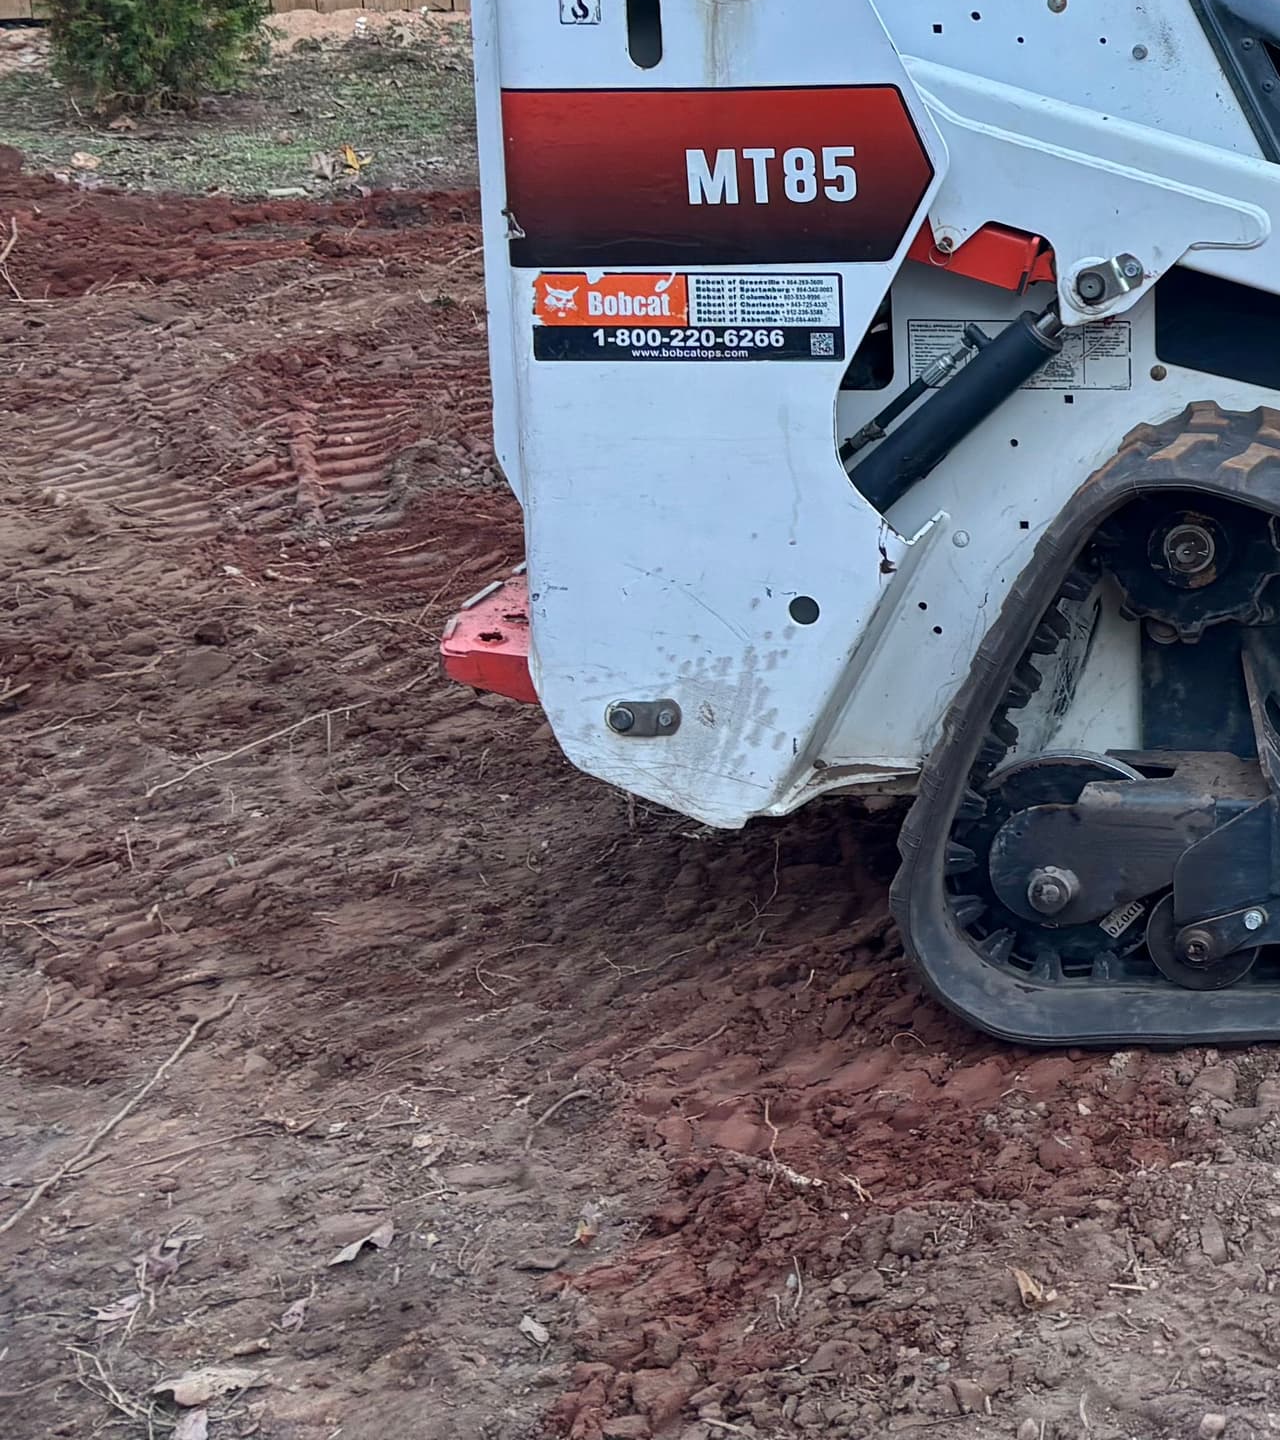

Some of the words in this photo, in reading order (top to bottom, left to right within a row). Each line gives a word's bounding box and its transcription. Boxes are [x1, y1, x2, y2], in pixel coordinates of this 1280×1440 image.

[685, 146, 858, 205] MT85
[588, 291, 670, 316] Bobcat
[592, 329, 785, 348] 1-800-220-6266
[631, 348, 749, 360] www.bobcatops.com
